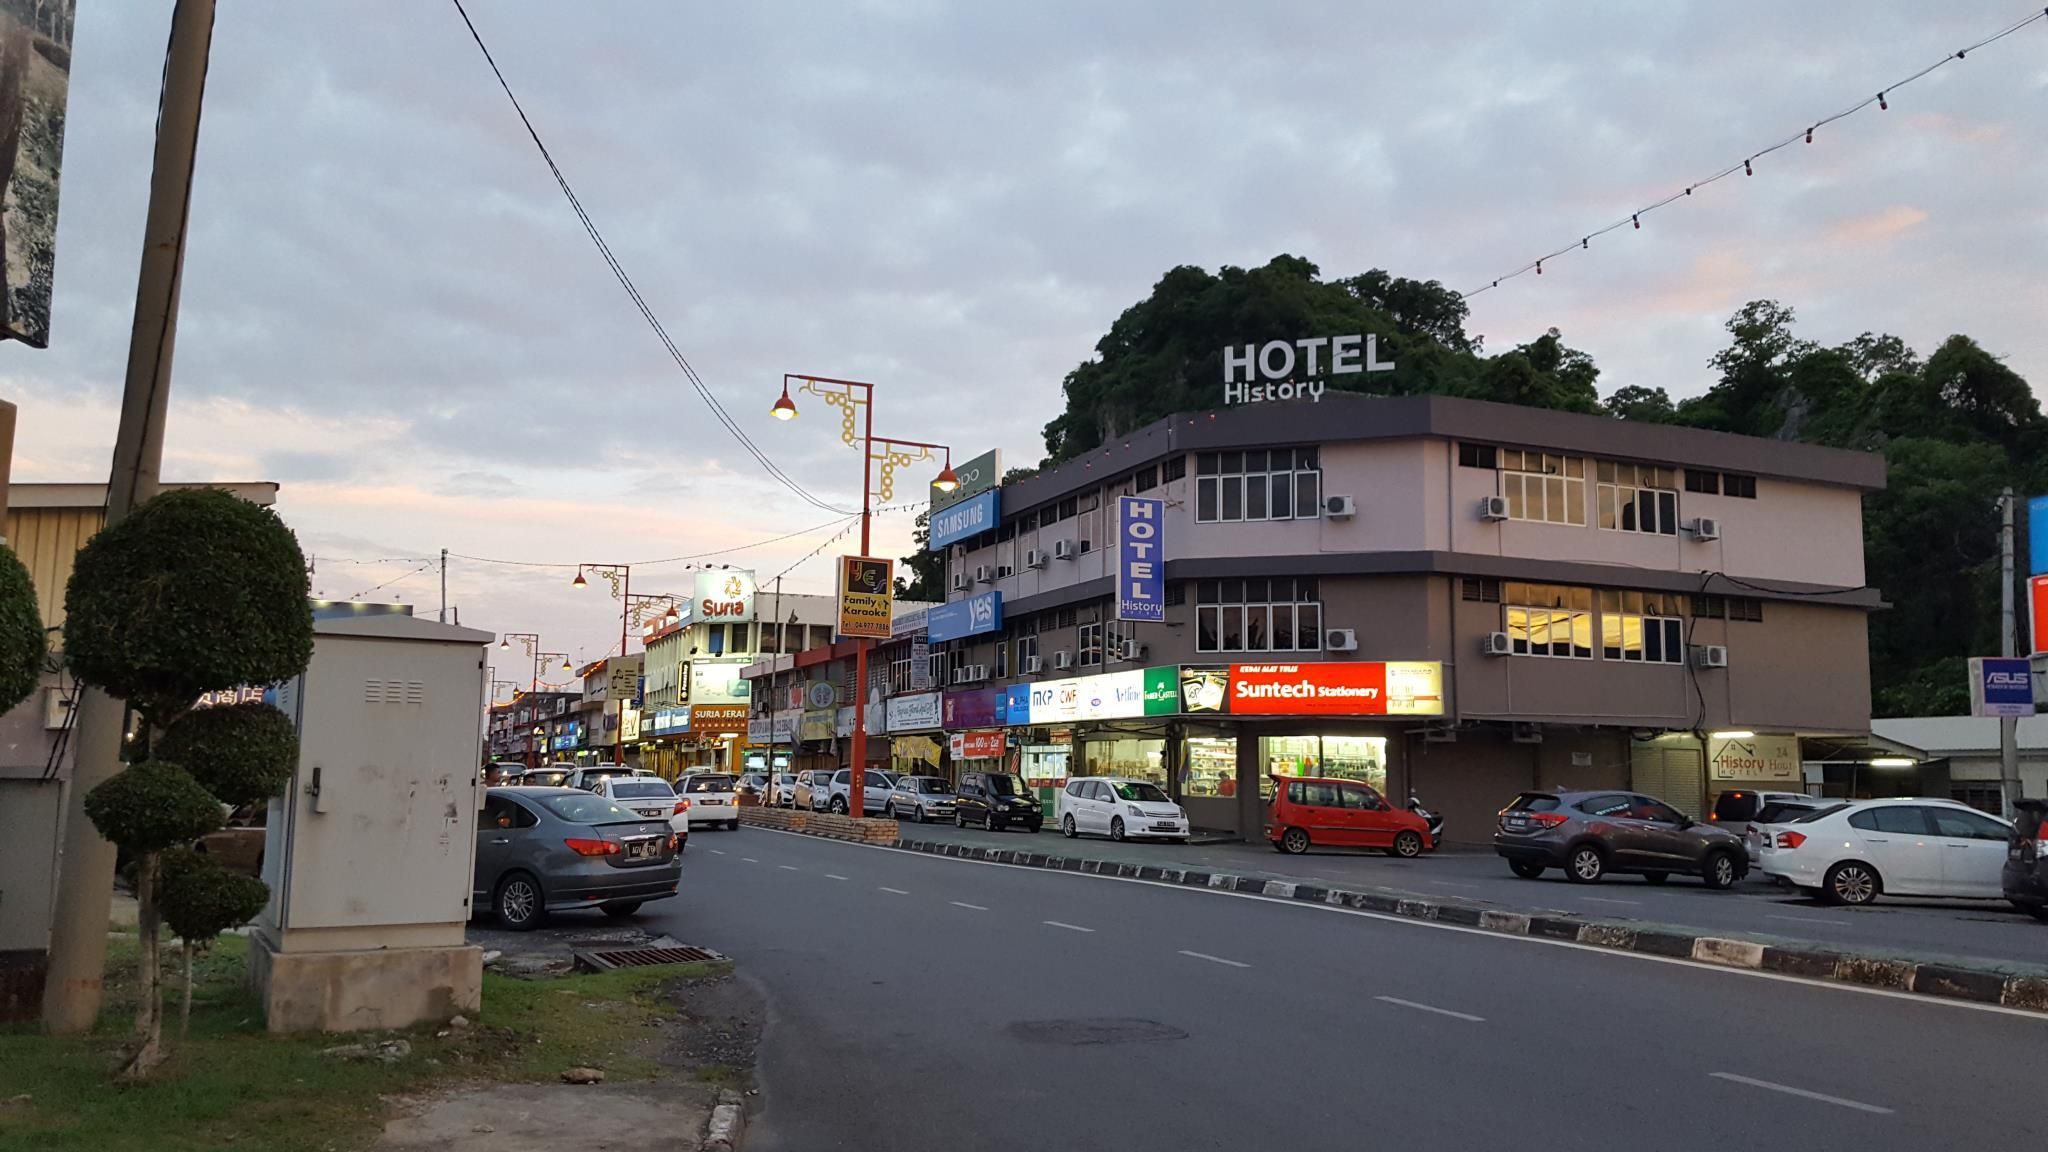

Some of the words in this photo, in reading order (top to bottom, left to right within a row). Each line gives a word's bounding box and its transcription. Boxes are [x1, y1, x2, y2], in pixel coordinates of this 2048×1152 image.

[1224, 333, 1395, 383] HOTEL
[1224, 381, 1325, 405] History
[937, 503, 983, 538] SAMSUNG
[1128, 501, 1155, 599] HOTEL
[702, 599, 744, 617] Suria
[844, 595, 877, 608] Family
[1121, 599, 1162, 616] History
[843, 605, 887, 617] Karaoke
[969, 596, 992, 632] yes
[1986, 672, 2028, 684] ASUS
[1236, 680, 1316, 698] Suntech
[1318, 686, 1379, 699] Stationery
[694, 710, 720, 718] SURIA
[722, 709, 745, 718] JERAI
[1720, 755, 1764, 773] History
